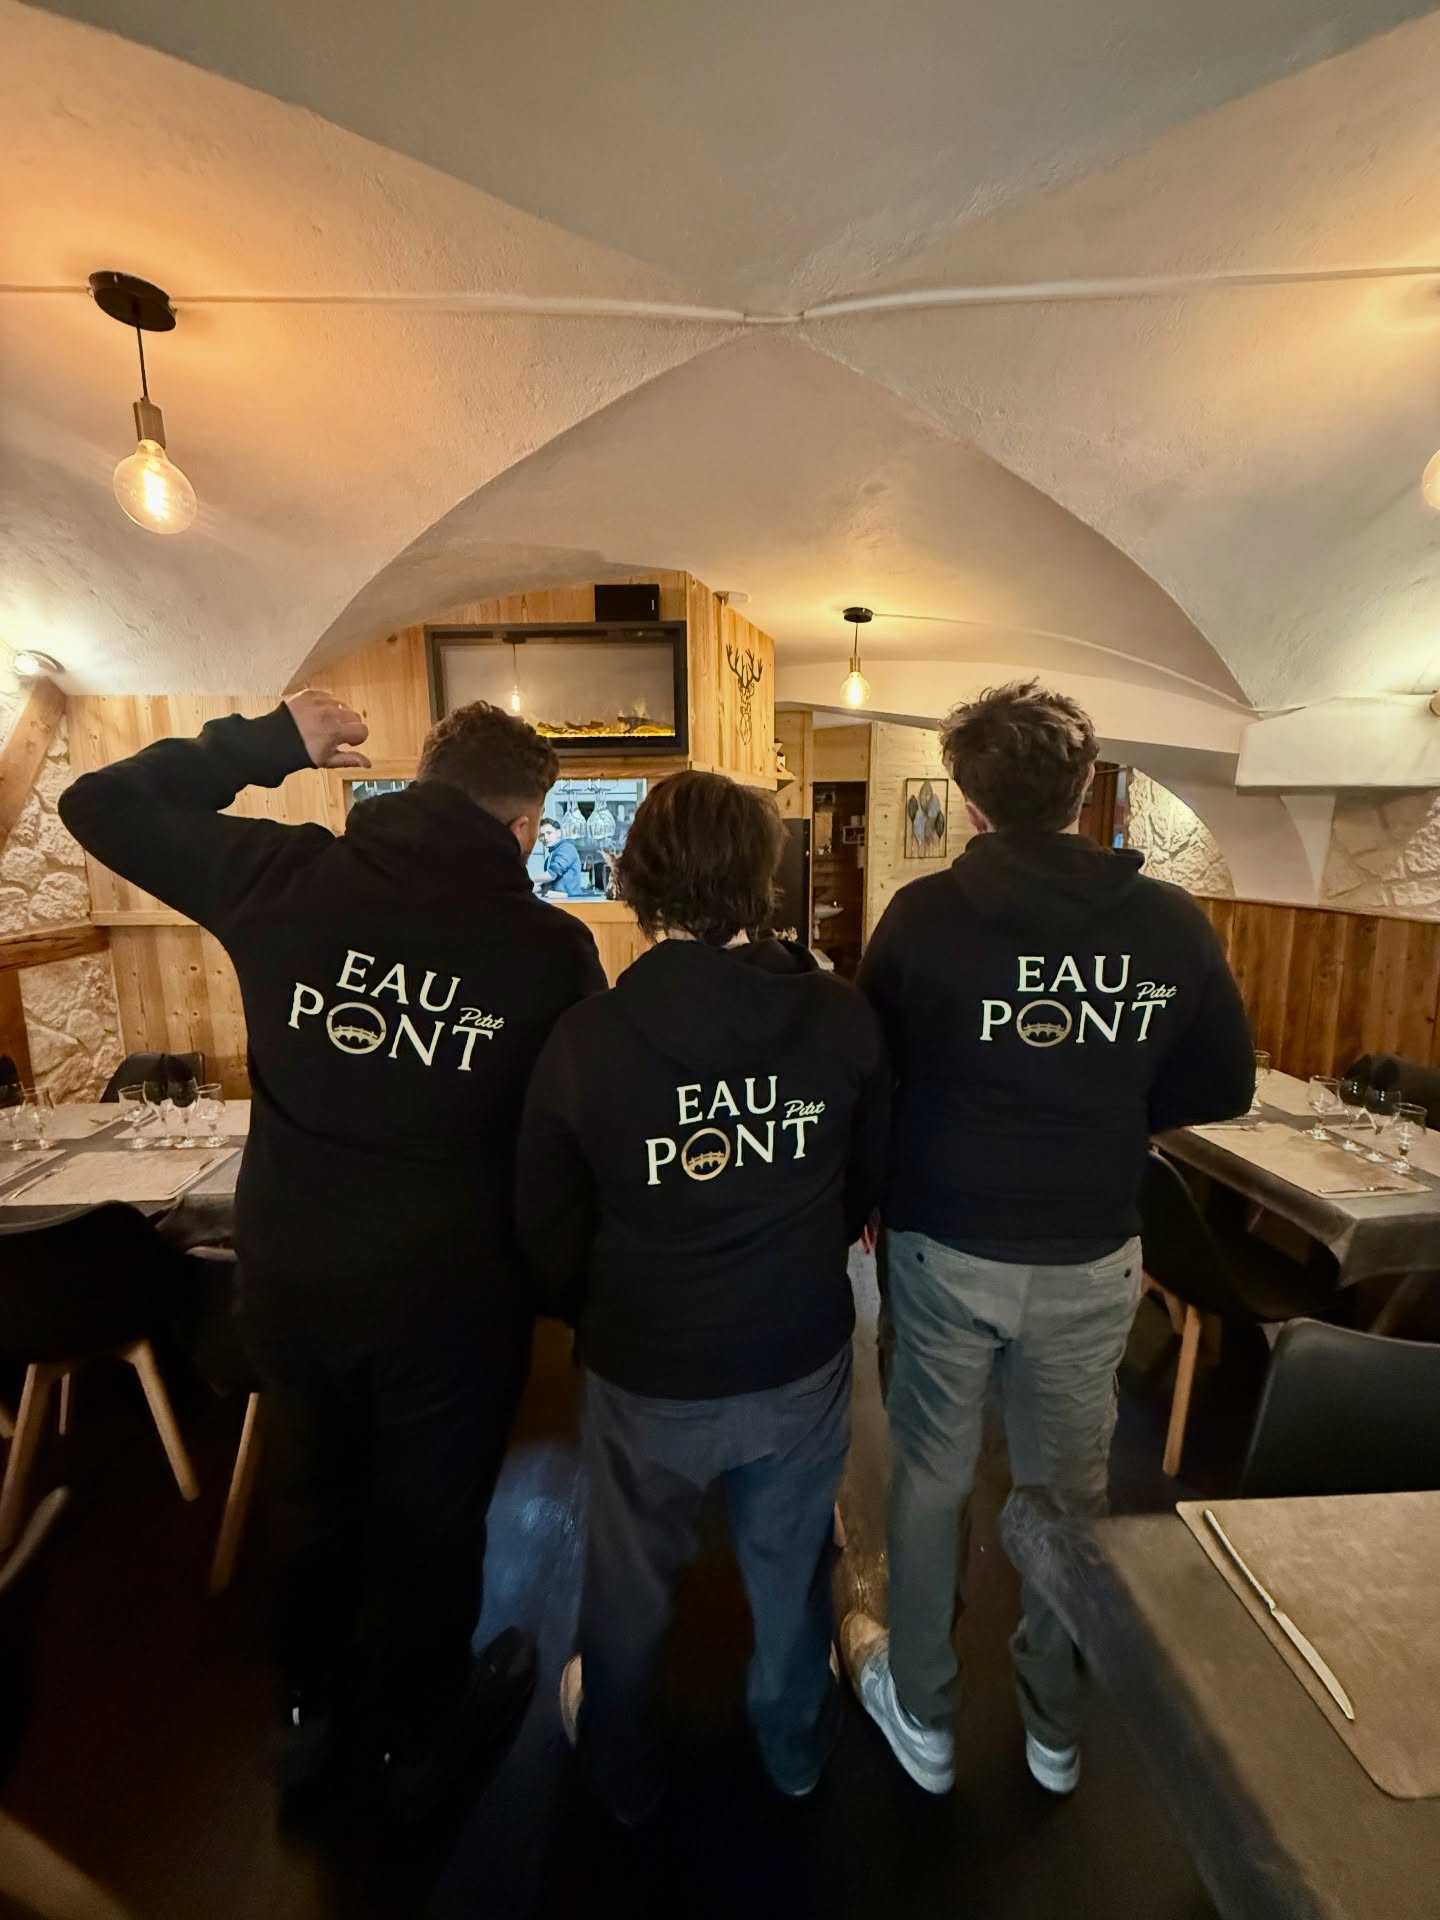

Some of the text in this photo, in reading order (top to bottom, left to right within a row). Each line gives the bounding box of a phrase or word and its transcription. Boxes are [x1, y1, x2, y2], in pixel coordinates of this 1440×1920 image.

[336, 949, 462, 1013] EAU
[1016, 954, 1131, 994] EAU
[1136, 981, 1178, 1000] Petit
[287, 982, 494, 1072] PONT
[459, 1007, 505, 1031] Petit
[979, 999, 1167, 1048] PONT
[676, 1075, 778, 1126] EAU
[783, 1099, 826, 1119] Petit
[645, 1115, 819, 1186] PONT
